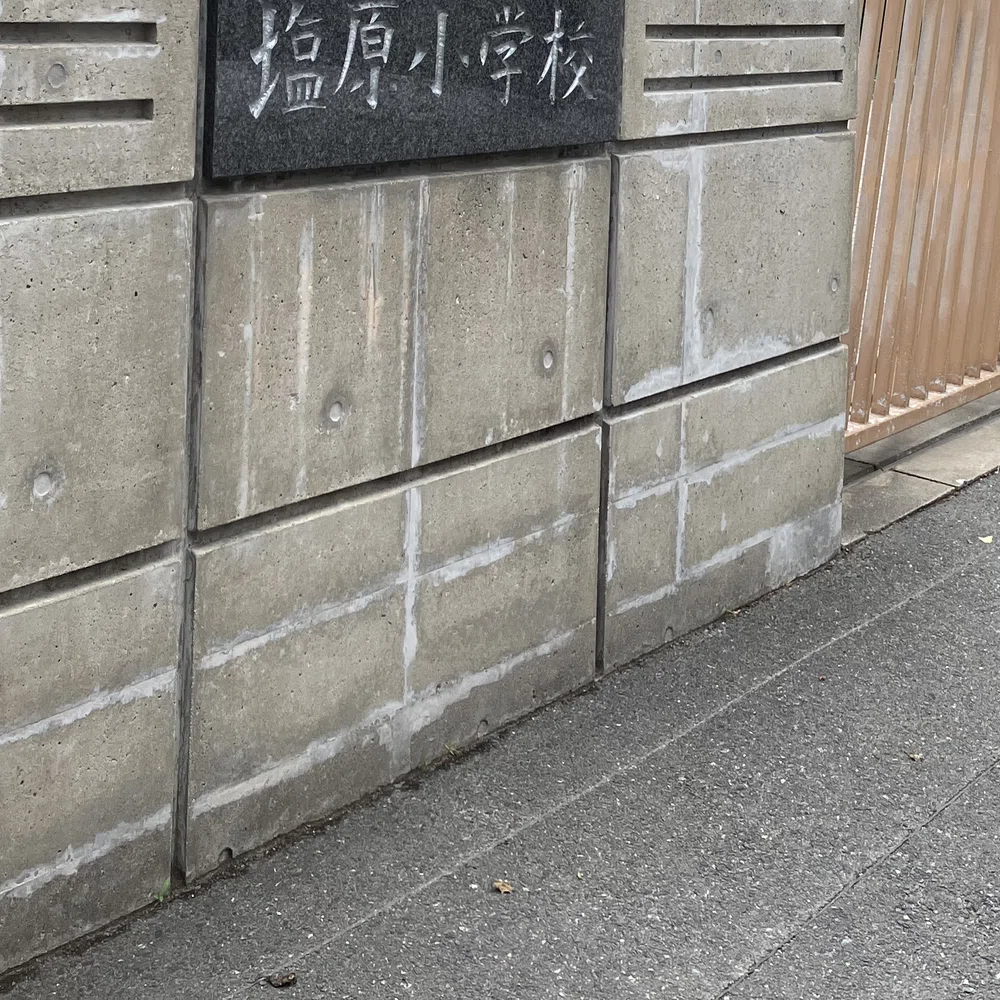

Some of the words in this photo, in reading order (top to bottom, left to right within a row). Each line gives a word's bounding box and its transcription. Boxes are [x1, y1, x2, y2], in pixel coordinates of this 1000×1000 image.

[249, 0, 598, 120] 塩原小学校
